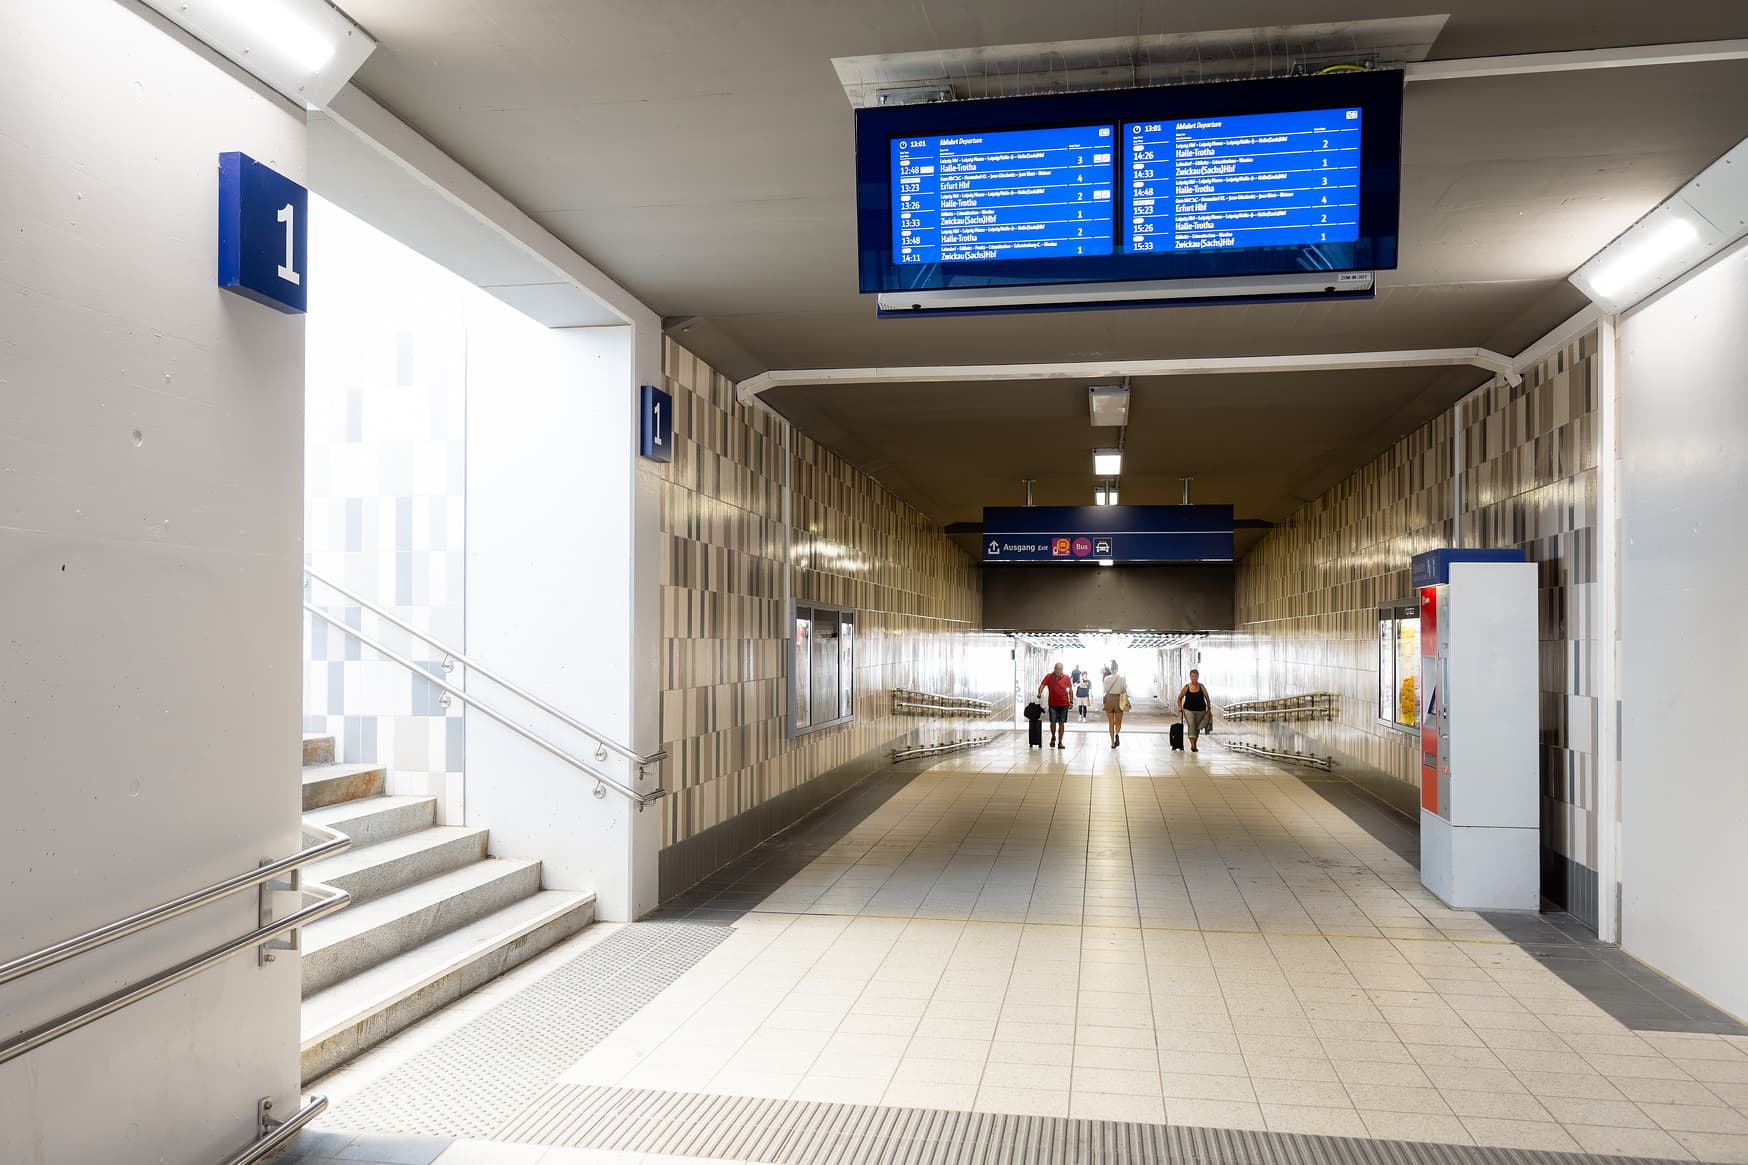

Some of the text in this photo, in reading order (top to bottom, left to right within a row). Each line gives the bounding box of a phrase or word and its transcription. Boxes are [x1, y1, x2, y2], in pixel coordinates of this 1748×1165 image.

[1323, 140, 1328, 148] 2
[1133, 152, 1154, 160] 14:26
[1176, 148, 1215, 157] Halle-Trotha
[1323, 159, 1327, 167] 1
[940, 163, 976, 172] Halle-Trotha
[1133, 170, 1154, 178] 14:33
[901, 184, 920, 192] 13:23
[958, 181, 970, 189] Hbf
[1133, 188, 1154, 196] 14:48
[1176, 185, 1214, 194] Halle-Trotha
[941, 199, 977, 208] Halle-Trotha
[1321, 196, 1327, 204] 4
[1133, 206, 1154, 214] 15:23
[1176, 203, 1208, 212] Erfurt Hbf
[1321, 214, 1327, 222] 2
[1133, 224, 1154, 232] 15:26
[1176, 221, 1214, 230] Halle-Trotha
[941, 235, 977, 243] Halle-Trotha
[1321, 233, 1326, 241] 1
[277, 203, 300, 286] 1
[1133, 242, 1154, 250] 15:33
[654, 402, 662, 446] 1
[1003, 543, 1036, 553] Ausgang
